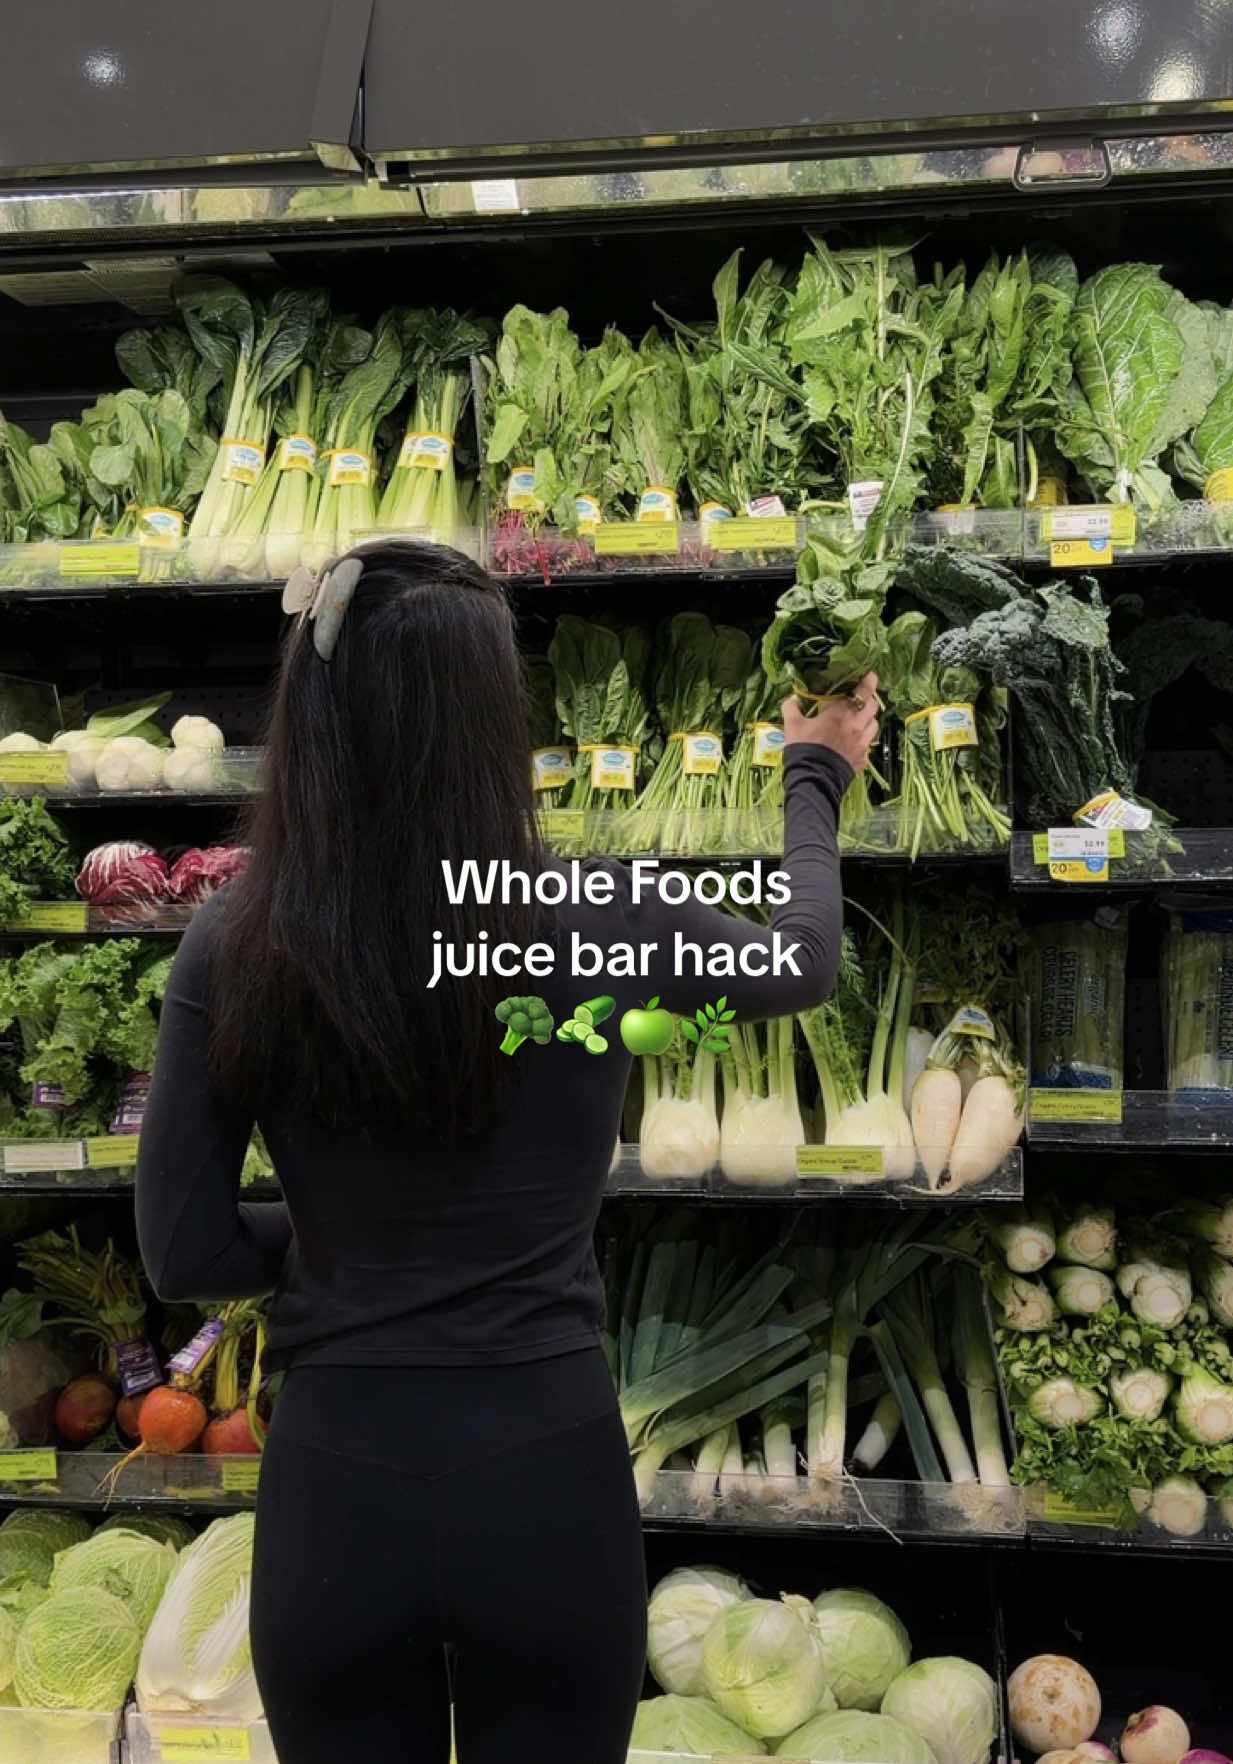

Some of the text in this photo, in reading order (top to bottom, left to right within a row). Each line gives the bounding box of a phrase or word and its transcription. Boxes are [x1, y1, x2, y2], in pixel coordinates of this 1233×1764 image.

[1052, 543, 1071, 554] 20
[1051, 863, 1067, 874] 20
[1055, 951, 1077, 1037] CELERY HEARTS
